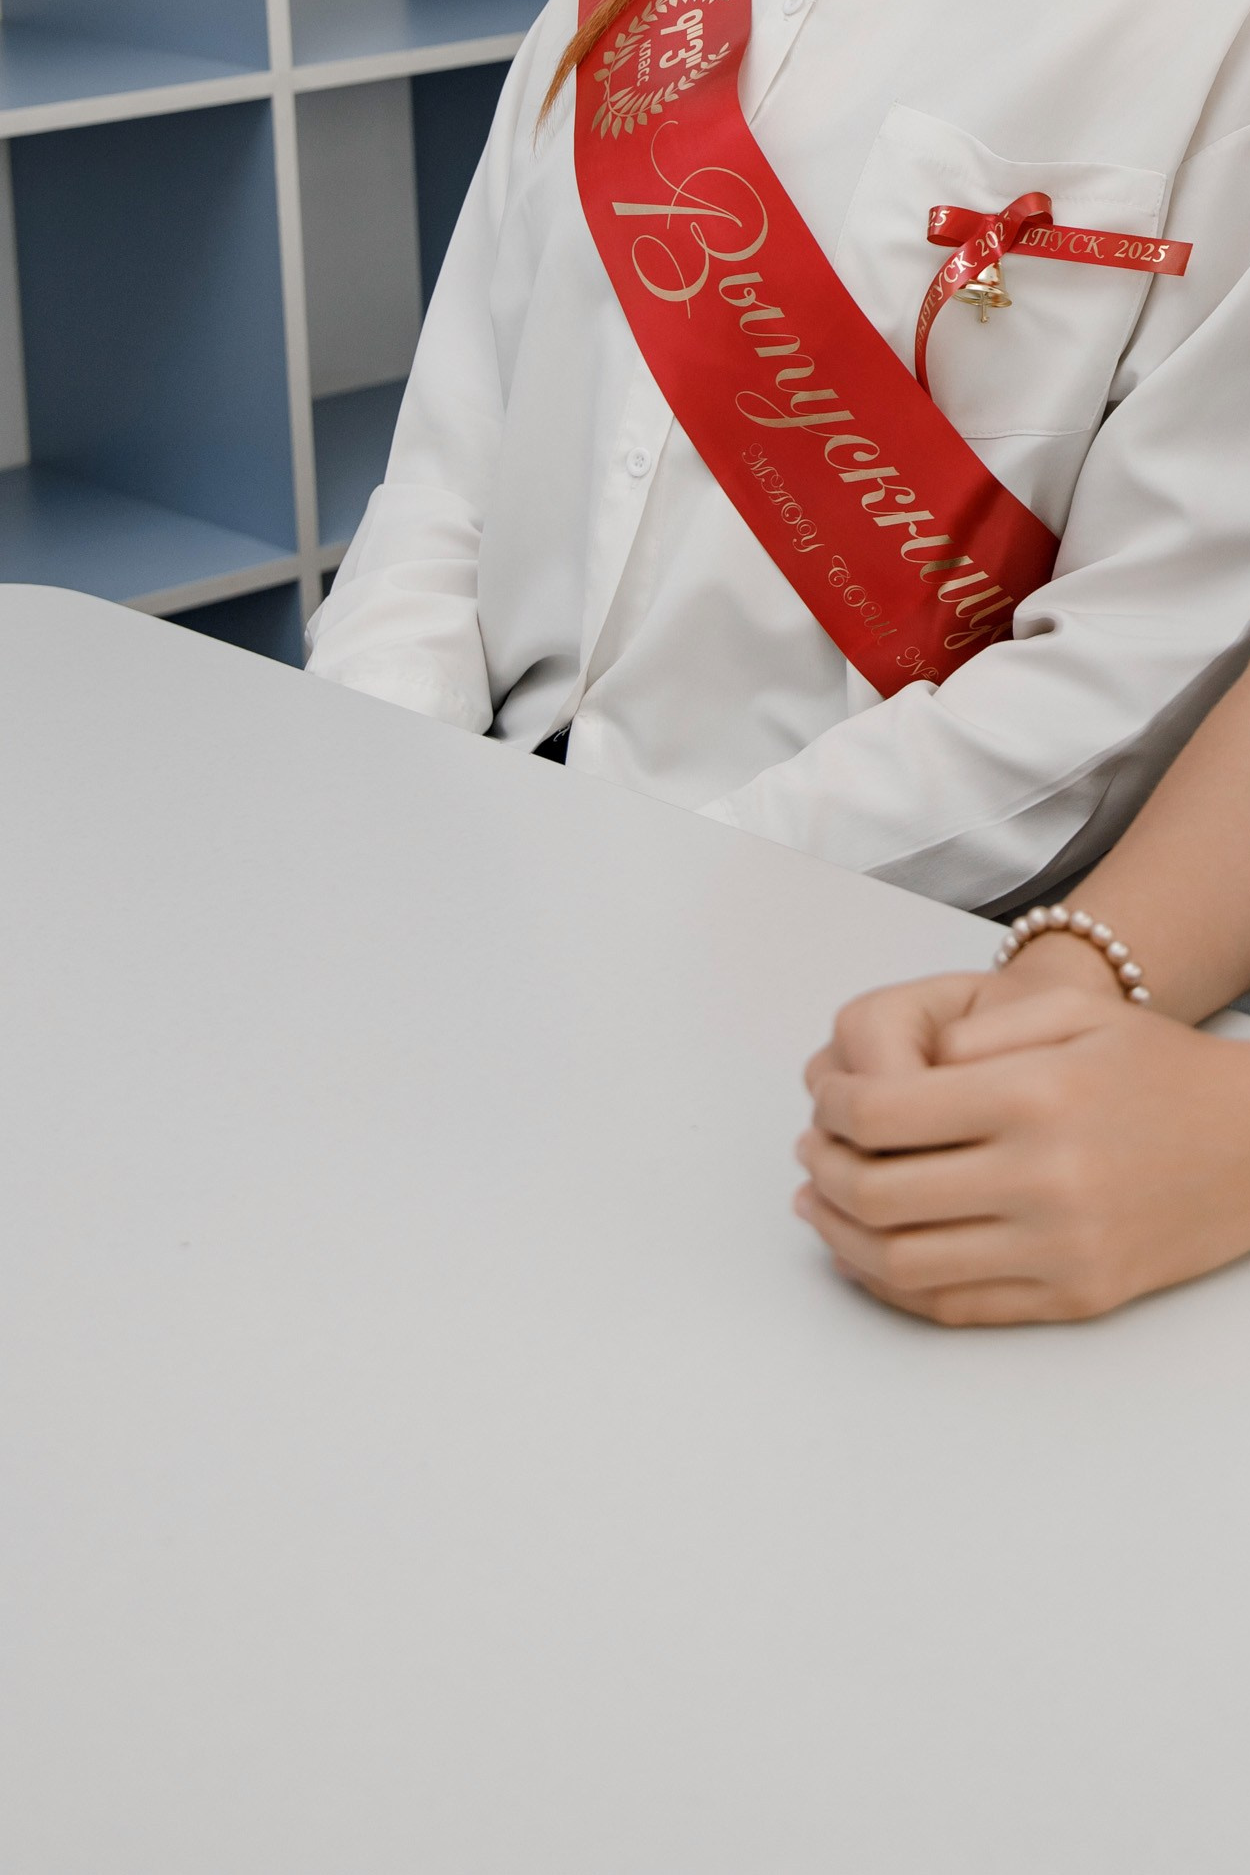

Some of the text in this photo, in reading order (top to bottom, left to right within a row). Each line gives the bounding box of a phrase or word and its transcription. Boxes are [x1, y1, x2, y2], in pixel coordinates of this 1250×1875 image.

[636, 39, 652, 87] класс
[1114, 240, 1170, 263] 2025
[612, 120, 1014, 650] Выпускниц
[741, 442, 825, 553] МАОУ
